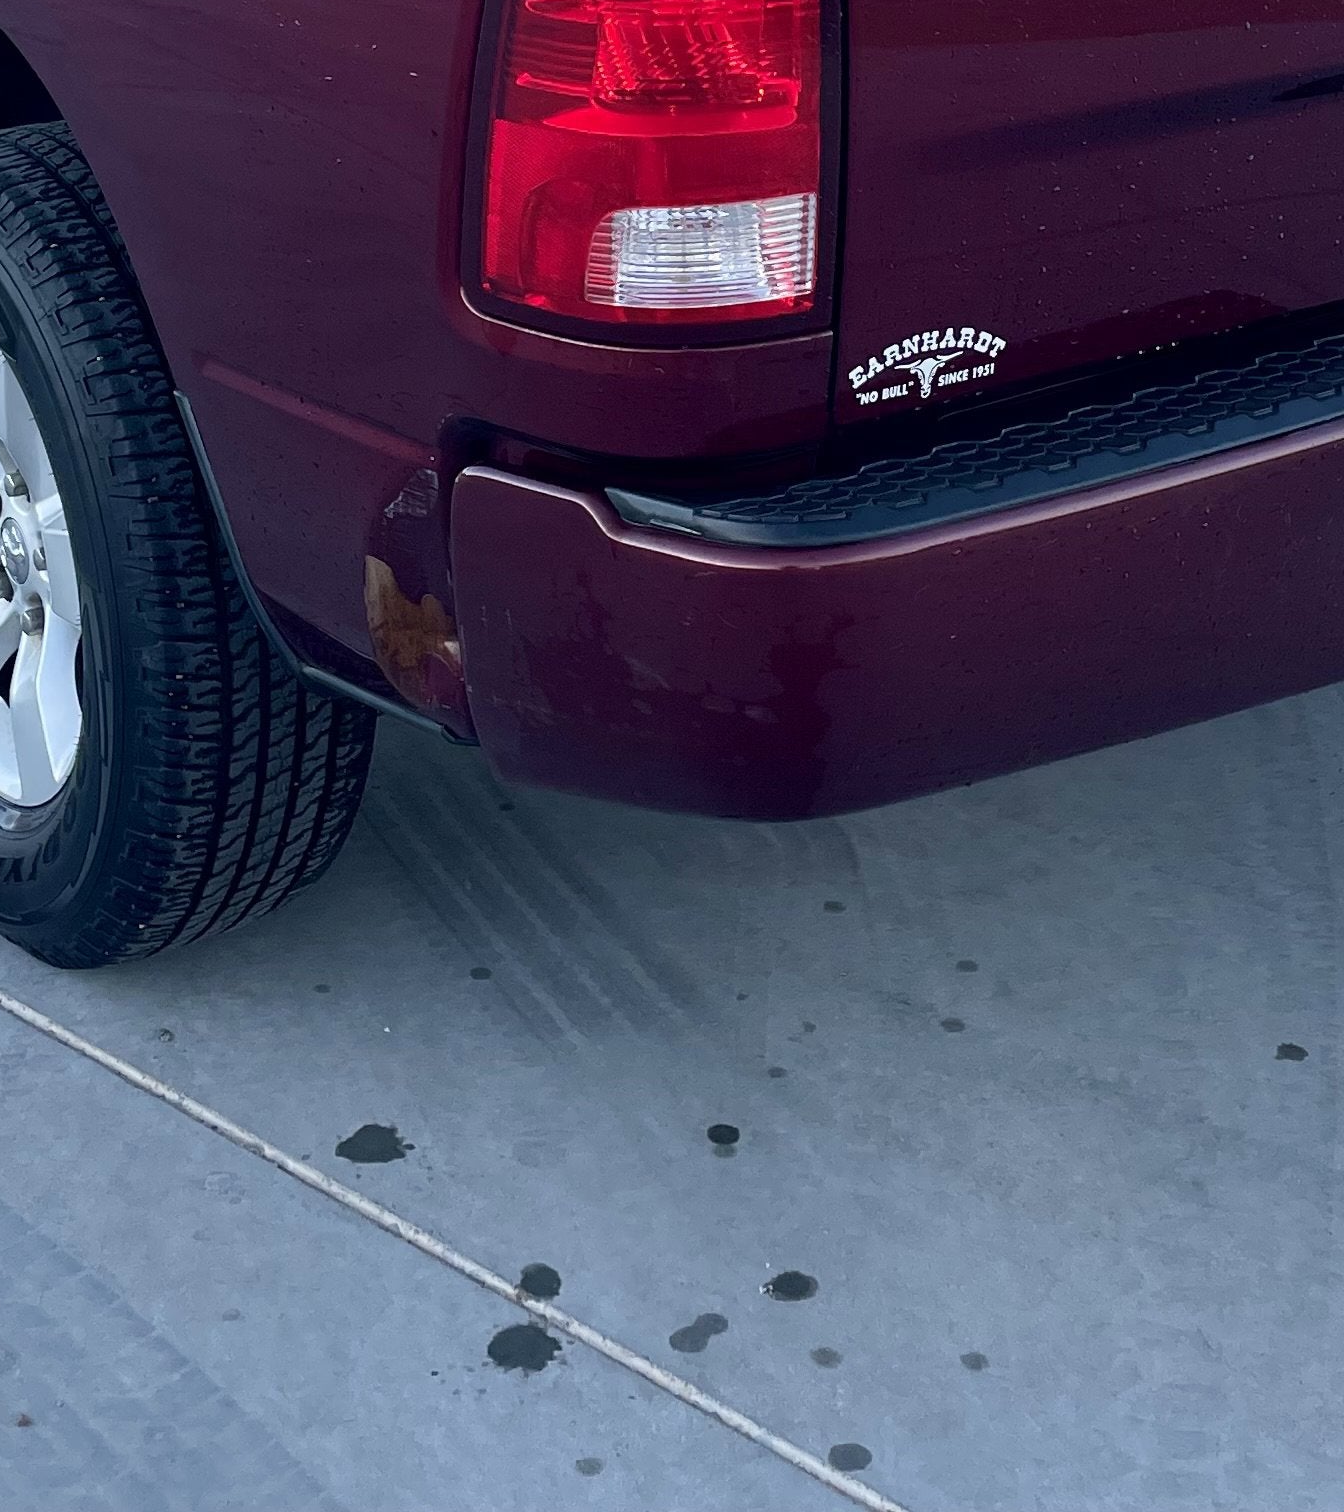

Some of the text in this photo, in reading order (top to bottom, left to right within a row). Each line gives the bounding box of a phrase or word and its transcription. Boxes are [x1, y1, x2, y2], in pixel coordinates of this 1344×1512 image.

[848, 327, 1007, 390] EARNHARDT
[937, 369, 969, 387] SINCE
[972, 362, 995, 379] 1951
